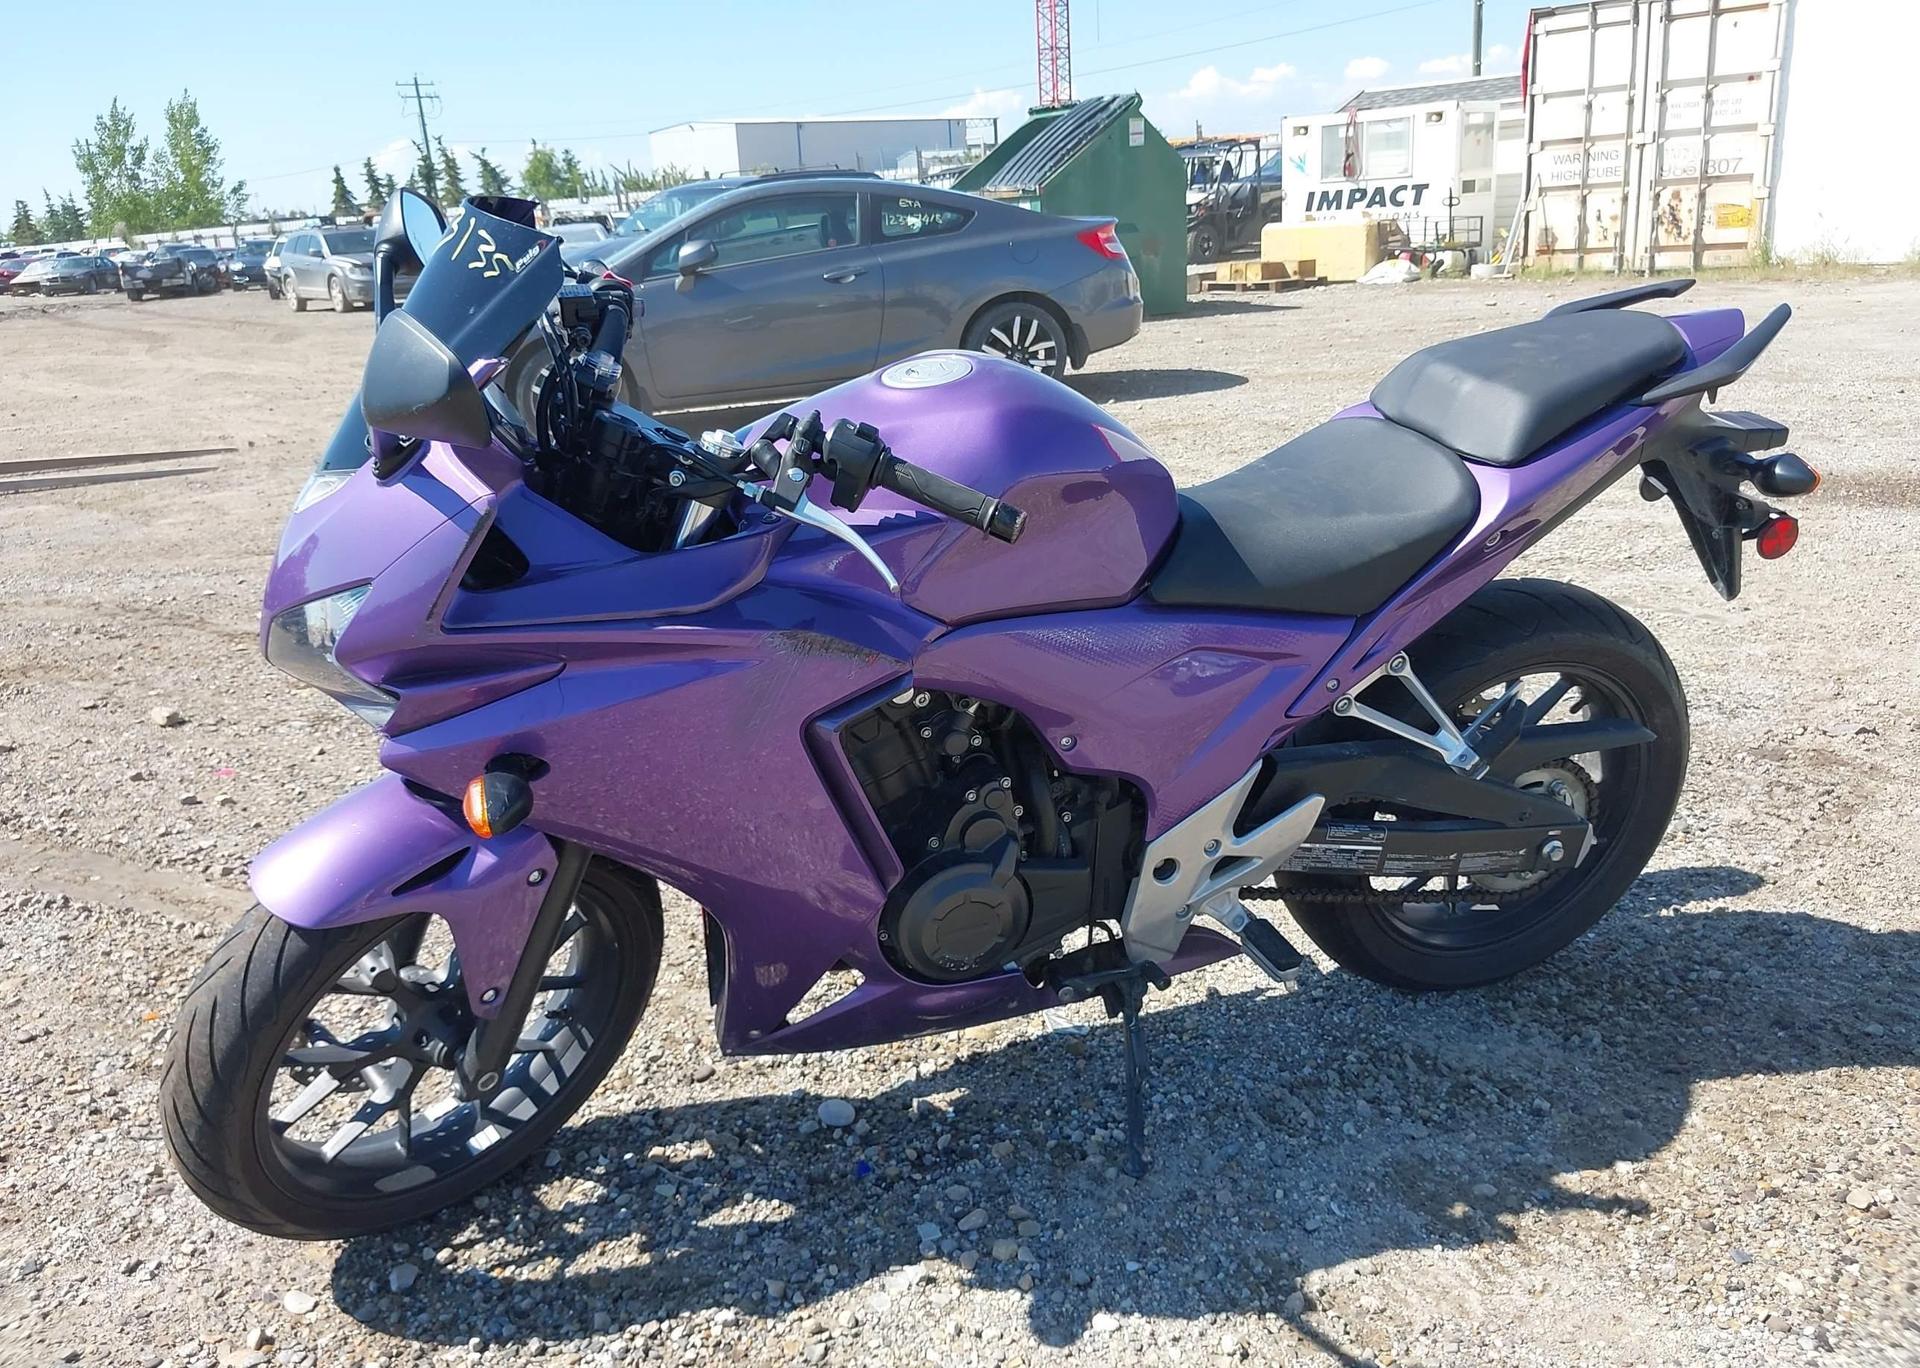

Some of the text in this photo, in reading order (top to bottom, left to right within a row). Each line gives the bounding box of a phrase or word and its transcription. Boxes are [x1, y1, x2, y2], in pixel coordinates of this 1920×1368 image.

[1553, 149, 1619, 165] WARNING
[1551, 165, 1622, 181] HIGH CUBE
[1305, 183, 1430, 212] IMPACT
